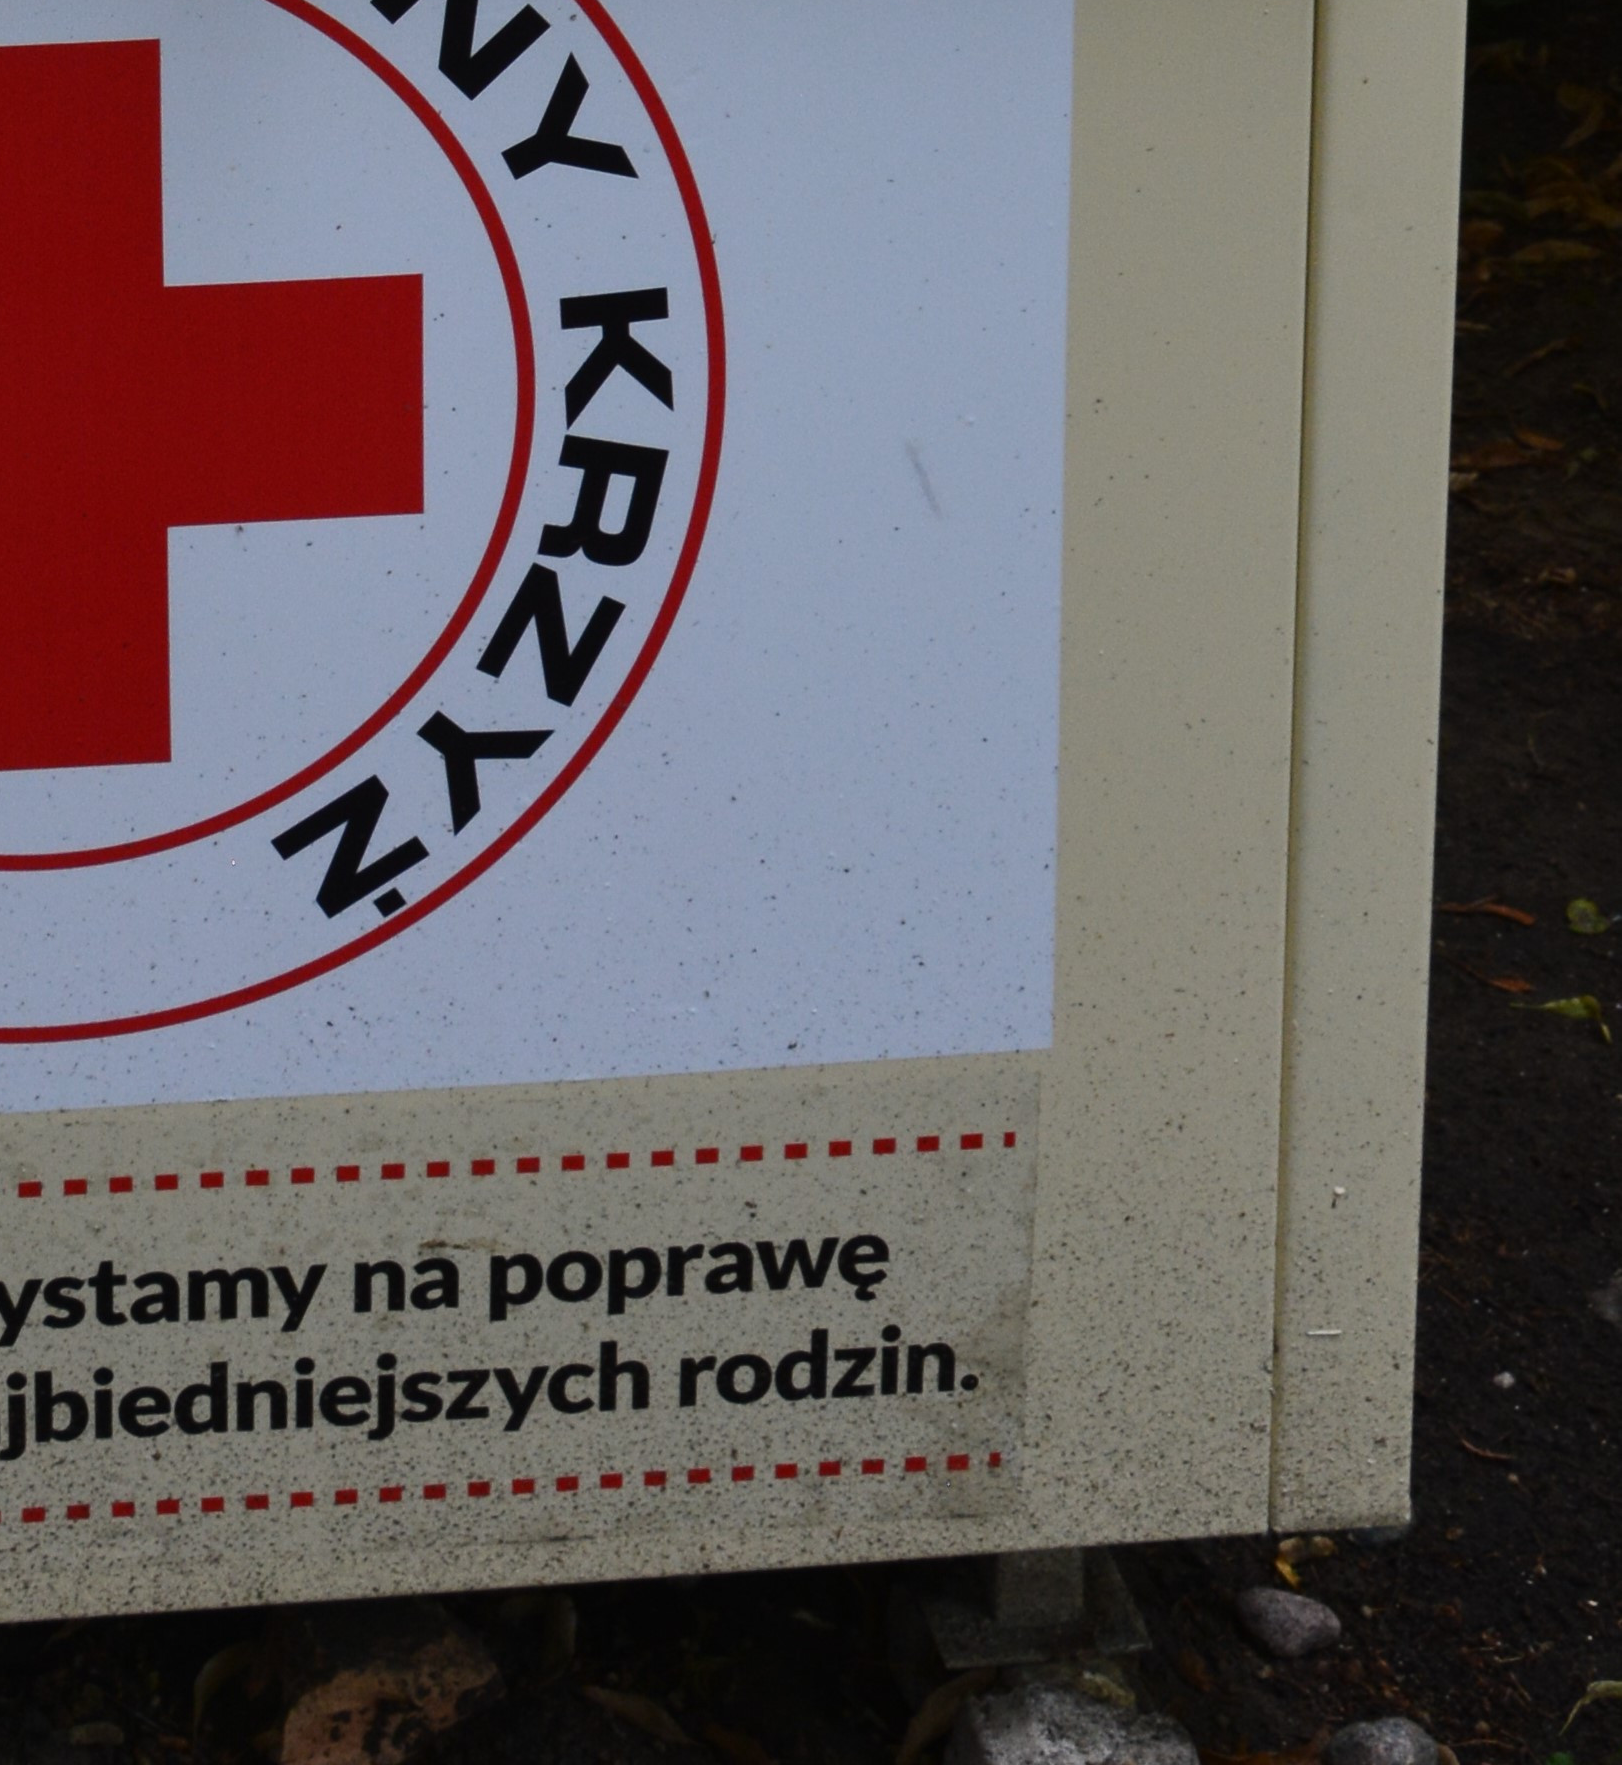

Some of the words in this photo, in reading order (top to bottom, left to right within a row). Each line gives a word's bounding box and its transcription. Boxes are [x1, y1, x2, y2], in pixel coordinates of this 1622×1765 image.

[273, 289, 672, 917] KRZYŻ
[354, 1258, 459, 1313] na
[490, 1235, 889, 1322] poprawę
[680, 1325, 978, 1407] rodzin.
